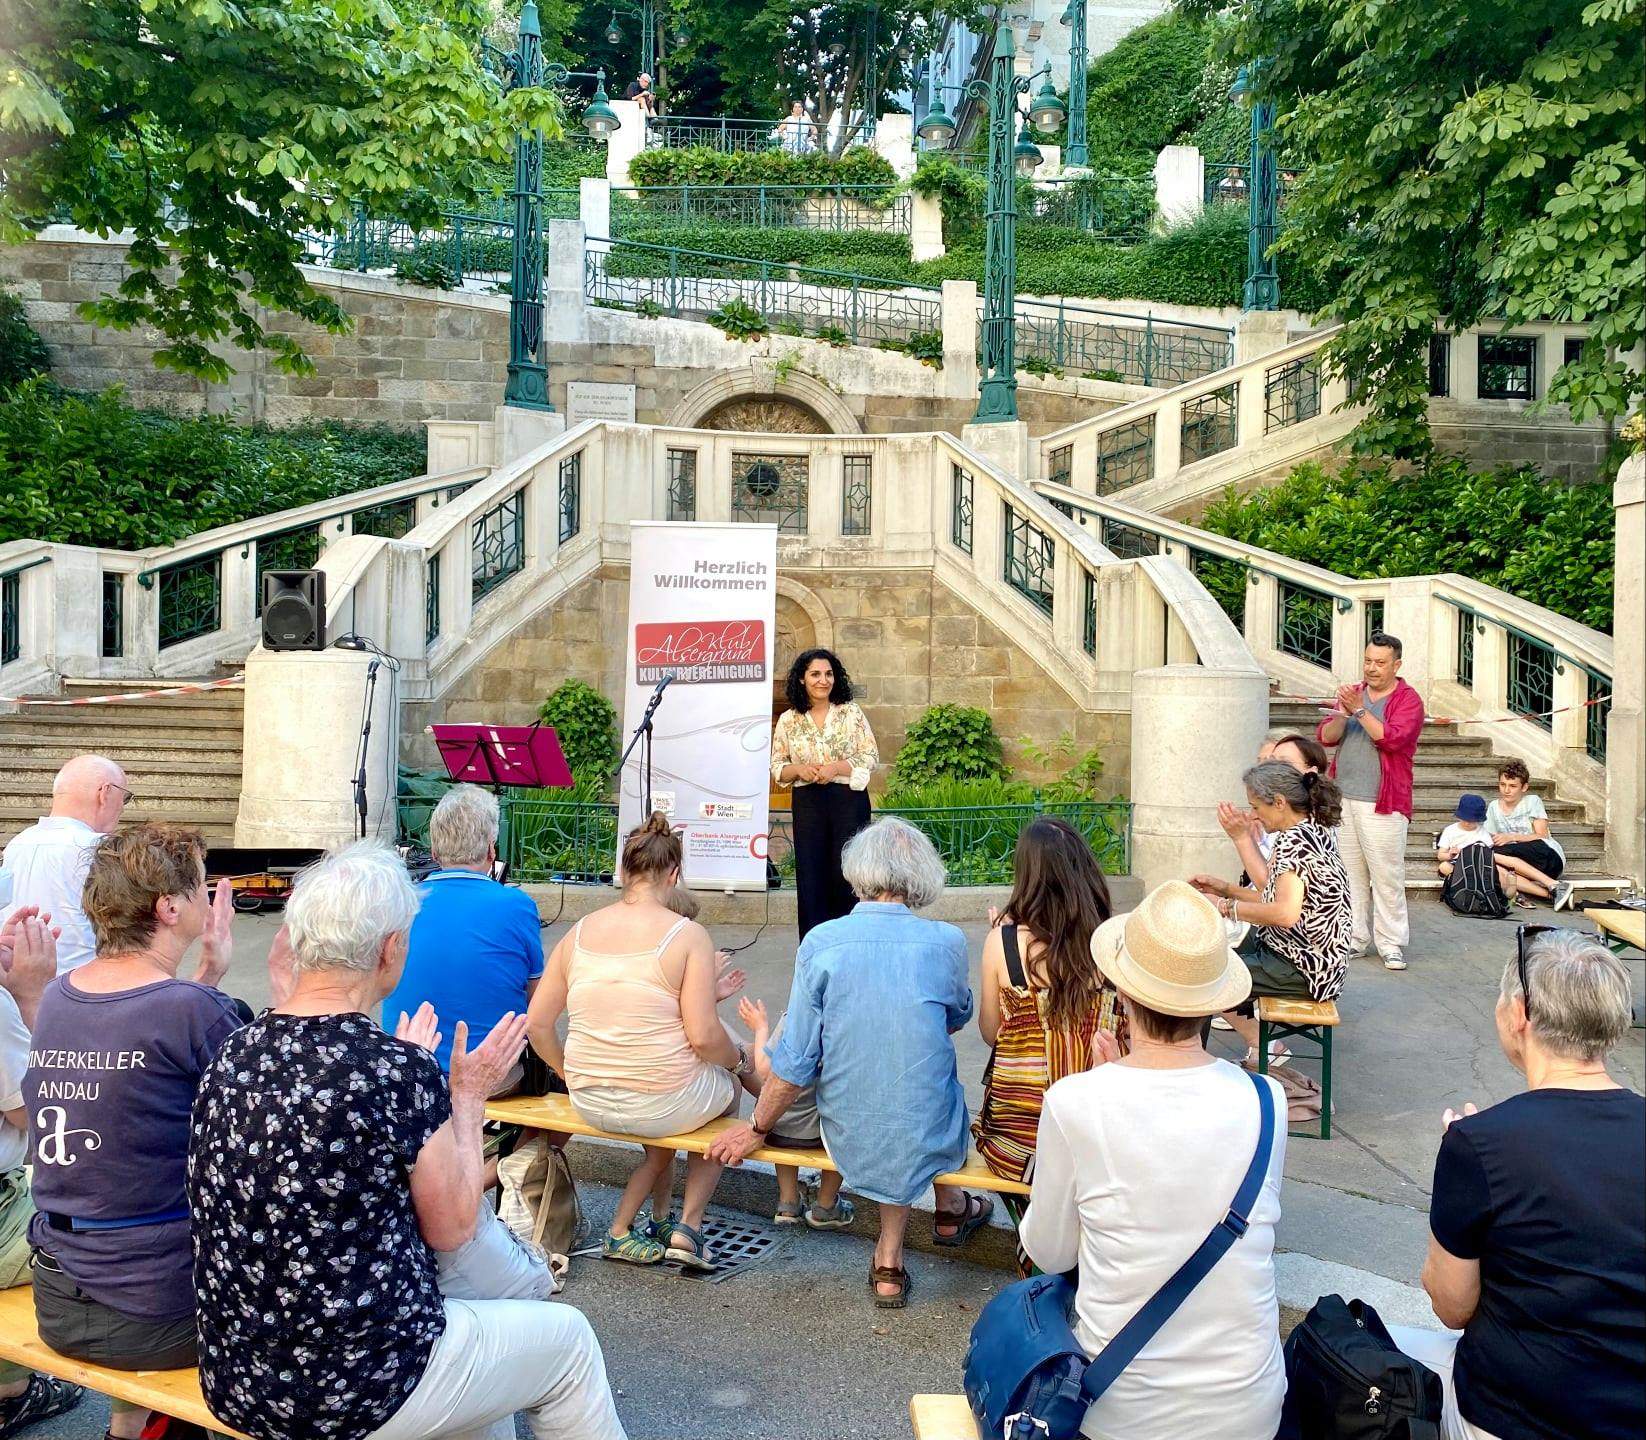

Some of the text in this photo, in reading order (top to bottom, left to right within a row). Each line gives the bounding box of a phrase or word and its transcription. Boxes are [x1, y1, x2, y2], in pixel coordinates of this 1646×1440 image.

[694, 560, 767, 575] Herzlich
[654, 574, 767, 590] Willkommen
[638, 627, 762, 677] Alsergrund
[29, 1049, 146, 1070] INZERKELLER
[37, 1080, 100, 1101] ANDAU
